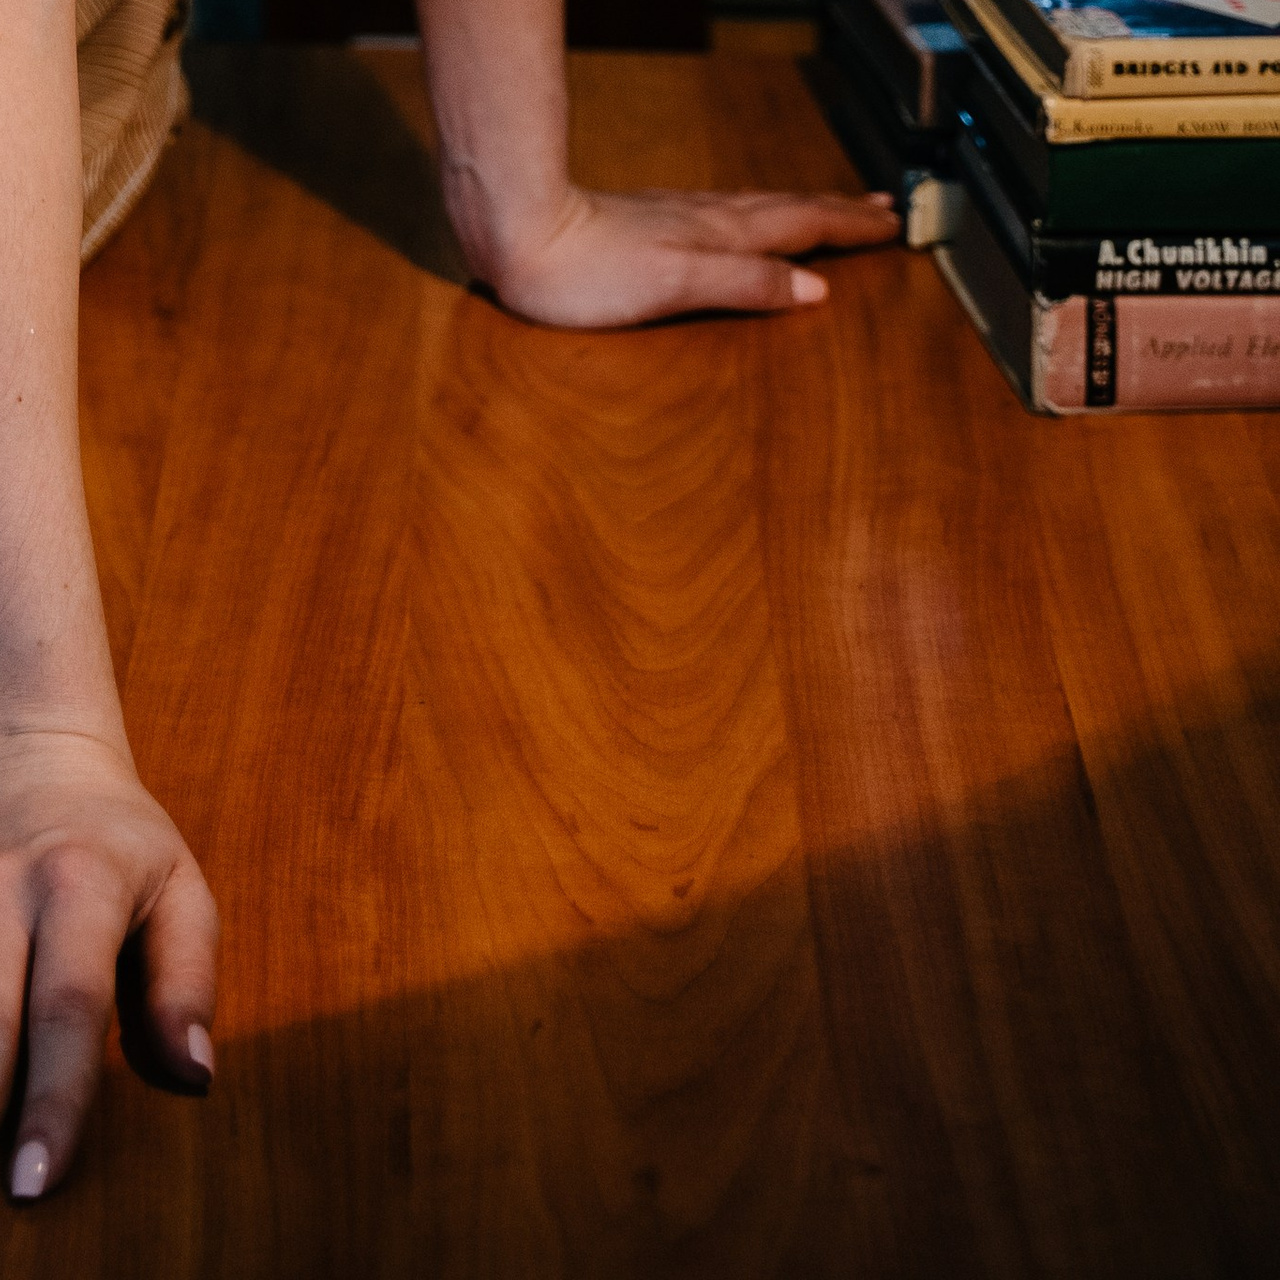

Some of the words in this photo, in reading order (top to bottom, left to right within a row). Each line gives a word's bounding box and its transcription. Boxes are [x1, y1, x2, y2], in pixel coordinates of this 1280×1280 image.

[1113, 58, 1201, 76] BRIDGES
[1212, 58, 1248, 75] AND
[1176, 119, 1229, 135] KNOW
[1095, 268, 1163, 291] HIGH
[1140, 333, 1234, 360] Applied
